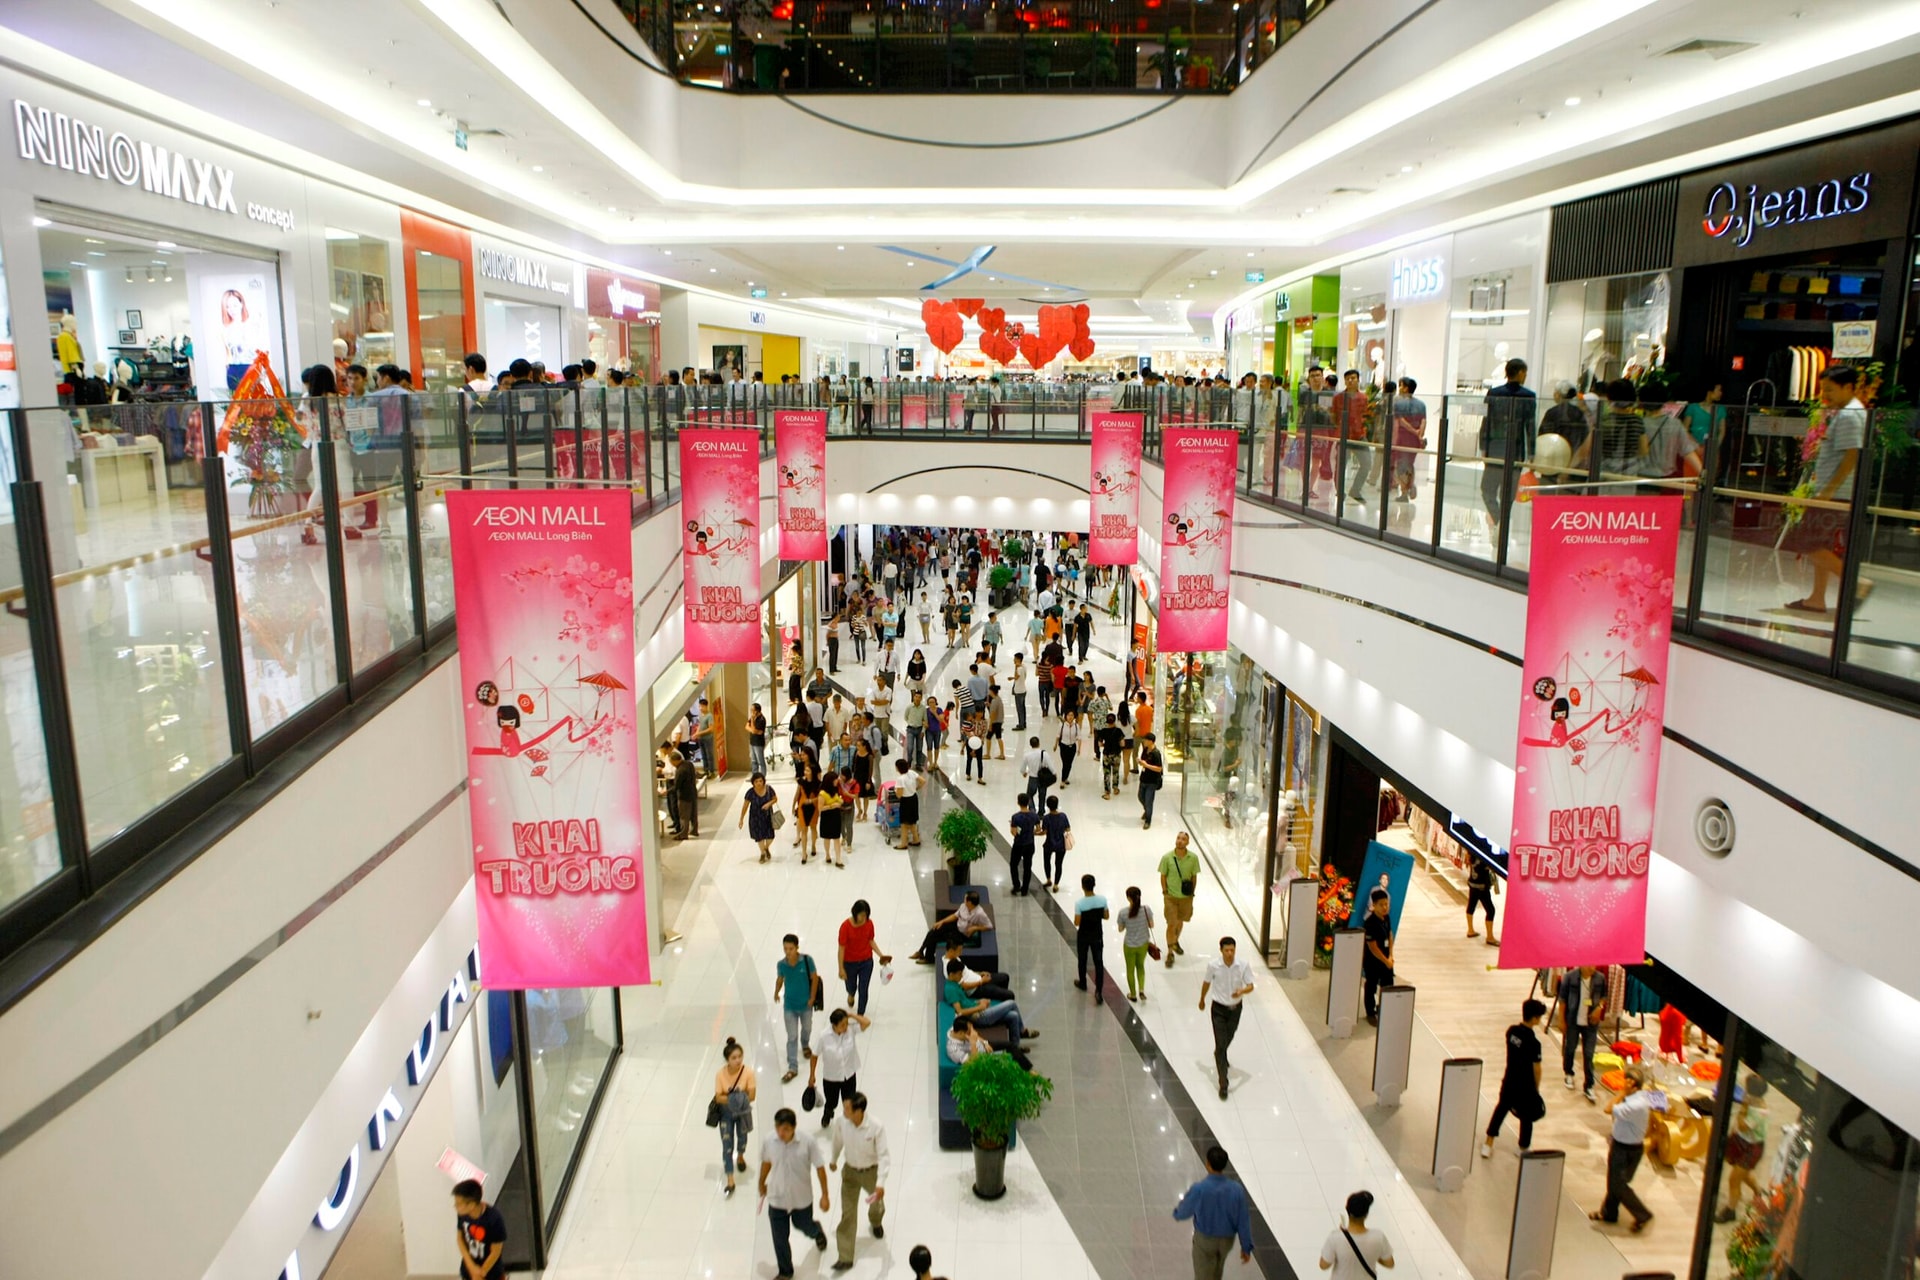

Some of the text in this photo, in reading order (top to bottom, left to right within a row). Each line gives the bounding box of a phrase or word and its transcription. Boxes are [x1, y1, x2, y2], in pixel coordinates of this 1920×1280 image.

[13, 99, 295, 232] NINOMAXX concept
[480, 248, 549, 290] NINOMAXX
[720, 442, 748, 451] MALL
[1203, 438, 1229, 447] MALL
[542, 506, 606, 526] MALL
[790, 507, 815, 519] KHAI
[1101, 514, 1127, 527] KHAI
[1607, 512, 1662, 530] MALL
[517, 532, 544, 541] MALL
[547, 532, 570, 543] Long
[572, 531, 592, 541] Biên
[1585, 536, 1608, 544] MALL
[1609, 536, 1629, 546] Long
[1630, 535, 1649, 544] Biên
[1178, 575, 1213, 591] KHAI
[701, 586, 742, 604] KHAI
[1550, 805, 1620, 843] KHAI
[512, 818, 600, 857] KHAI
